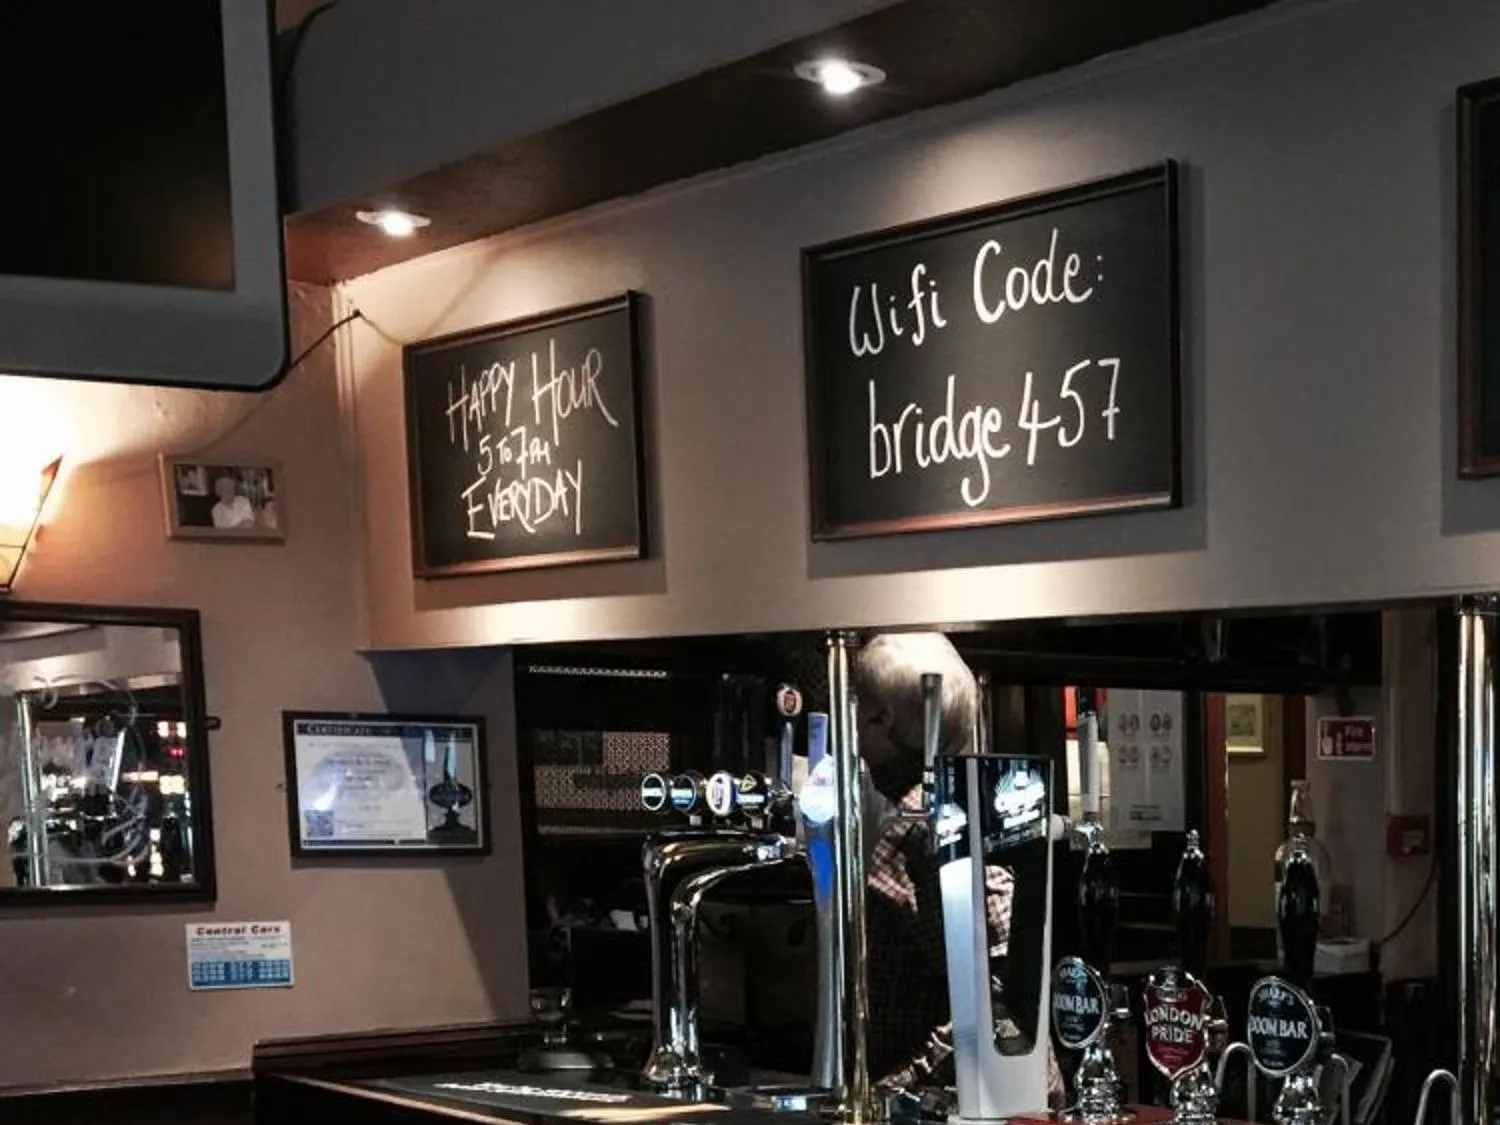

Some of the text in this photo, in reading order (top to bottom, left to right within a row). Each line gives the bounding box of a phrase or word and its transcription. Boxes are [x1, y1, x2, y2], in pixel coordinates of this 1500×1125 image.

[849, 263, 947, 356] Wifi
[478, 434, 493, 476] 5
[1143, 1003, 1203, 1031] LONDON
[1279, 1018, 1309, 1039] BAR
[1152, 1023, 1194, 1044] PRIDE
